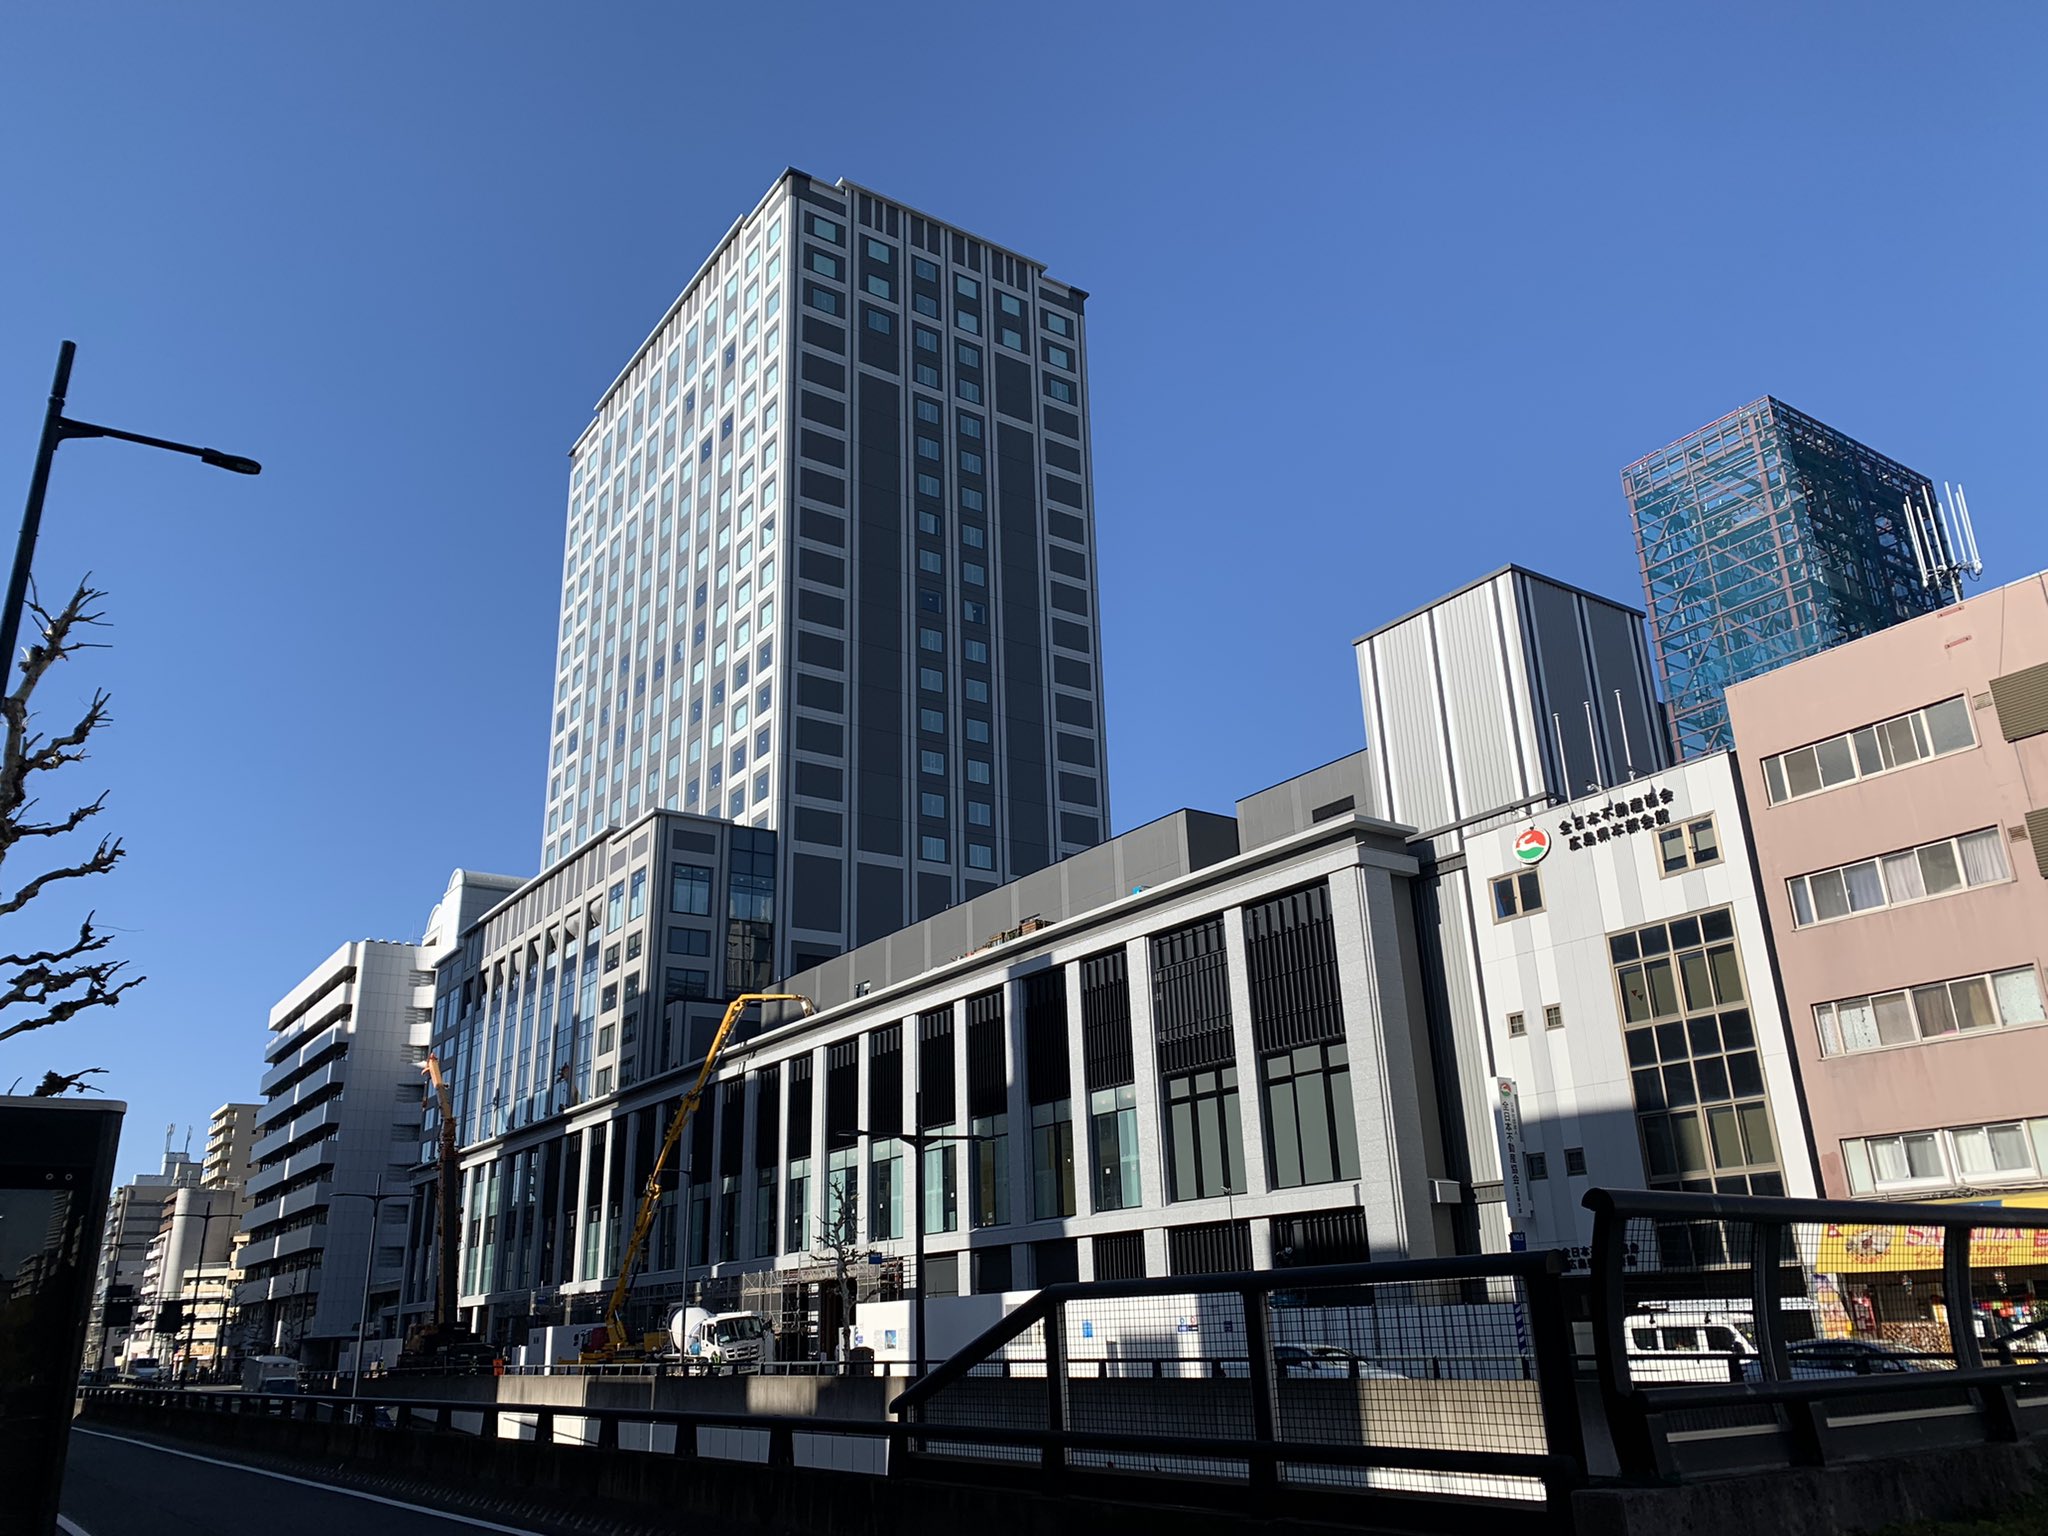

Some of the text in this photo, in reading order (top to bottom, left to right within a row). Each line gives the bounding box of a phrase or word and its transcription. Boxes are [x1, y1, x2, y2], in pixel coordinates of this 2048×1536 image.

[1558, 788, 1674, 836] 全日本不動産協会
[1569, 808, 1671, 851] 広島県本部会館
